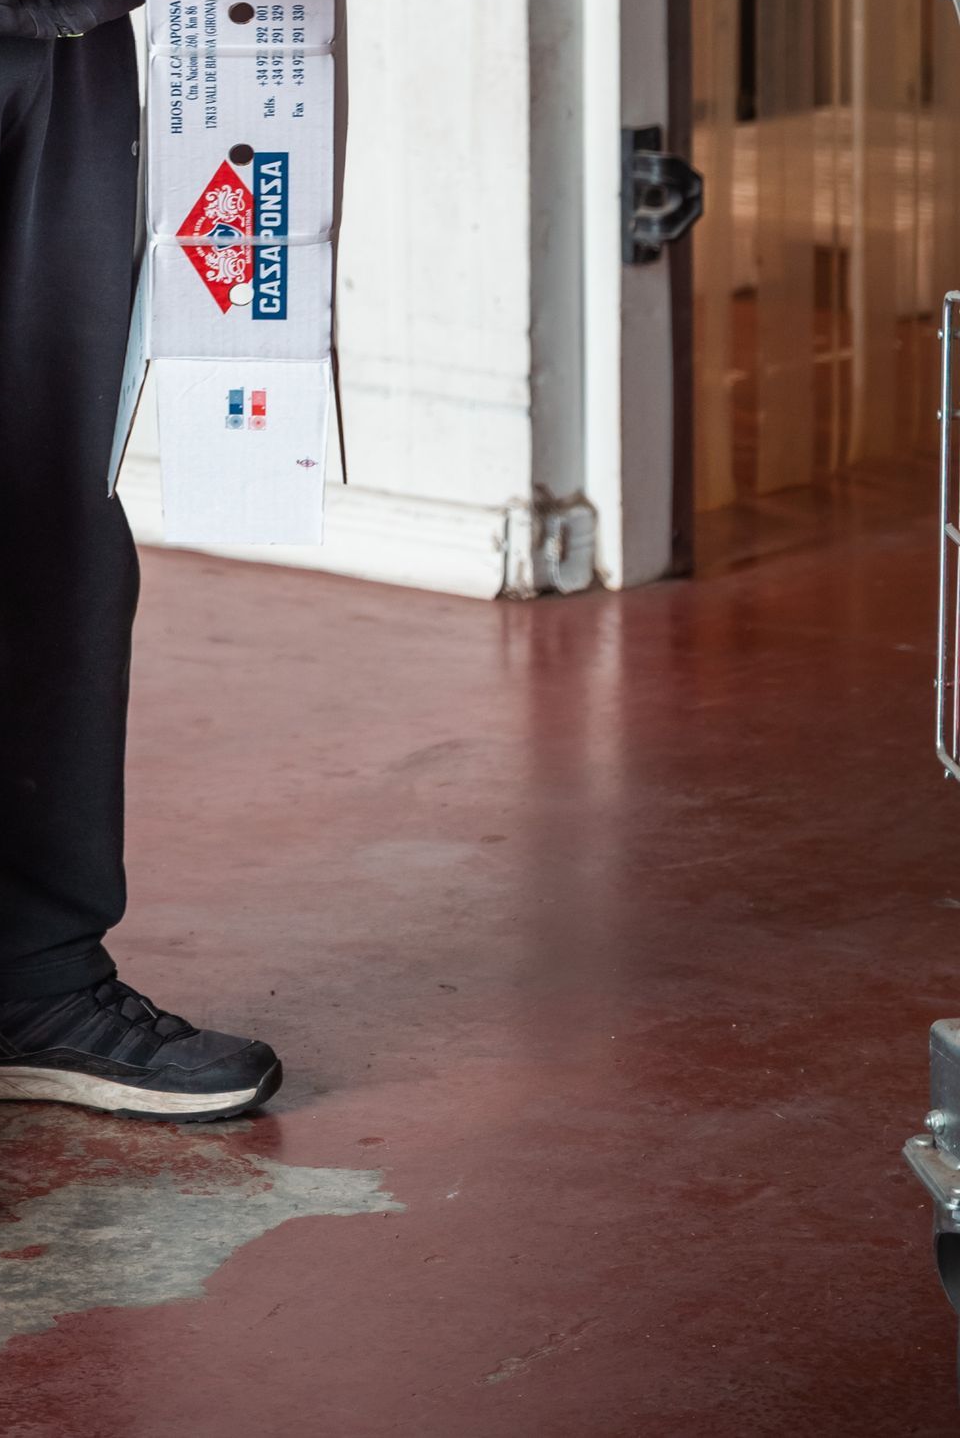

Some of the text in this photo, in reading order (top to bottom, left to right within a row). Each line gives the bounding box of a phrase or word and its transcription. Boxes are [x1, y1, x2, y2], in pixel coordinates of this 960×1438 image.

[185, 5, 198, 15] 86
[257, 5, 268, 21] 001
[272, 5, 284, 21] 329
[292, 5, 305, 21] 330
[185, 17, 198, 29] Km
[205, 0, 217, 38] (GIRONA)
[257, 26, 268, 43] 292
[272, 26, 284, 43] 291
[292, 26, 305, 43] 291
[186, 50, 198, 81] Nacion
[205, 71, 217, 82] DE
[257, 69, 268, 87] +34
[272, 69, 284, 87] +34
[292, 69, 305, 87] +34
[171, 81, 182, 97] DE
[186, 82, 198, 101] Ctra.
[205, 86, 217, 106] VALL
[264, 95, 276, 118] Telfs.
[292, 102, 304, 118] Fax
[171, 100, 183, 134] HIJOS
[206, 106, 217, 129] 17813
[259, 161, 283, 314] CASAPONSA
